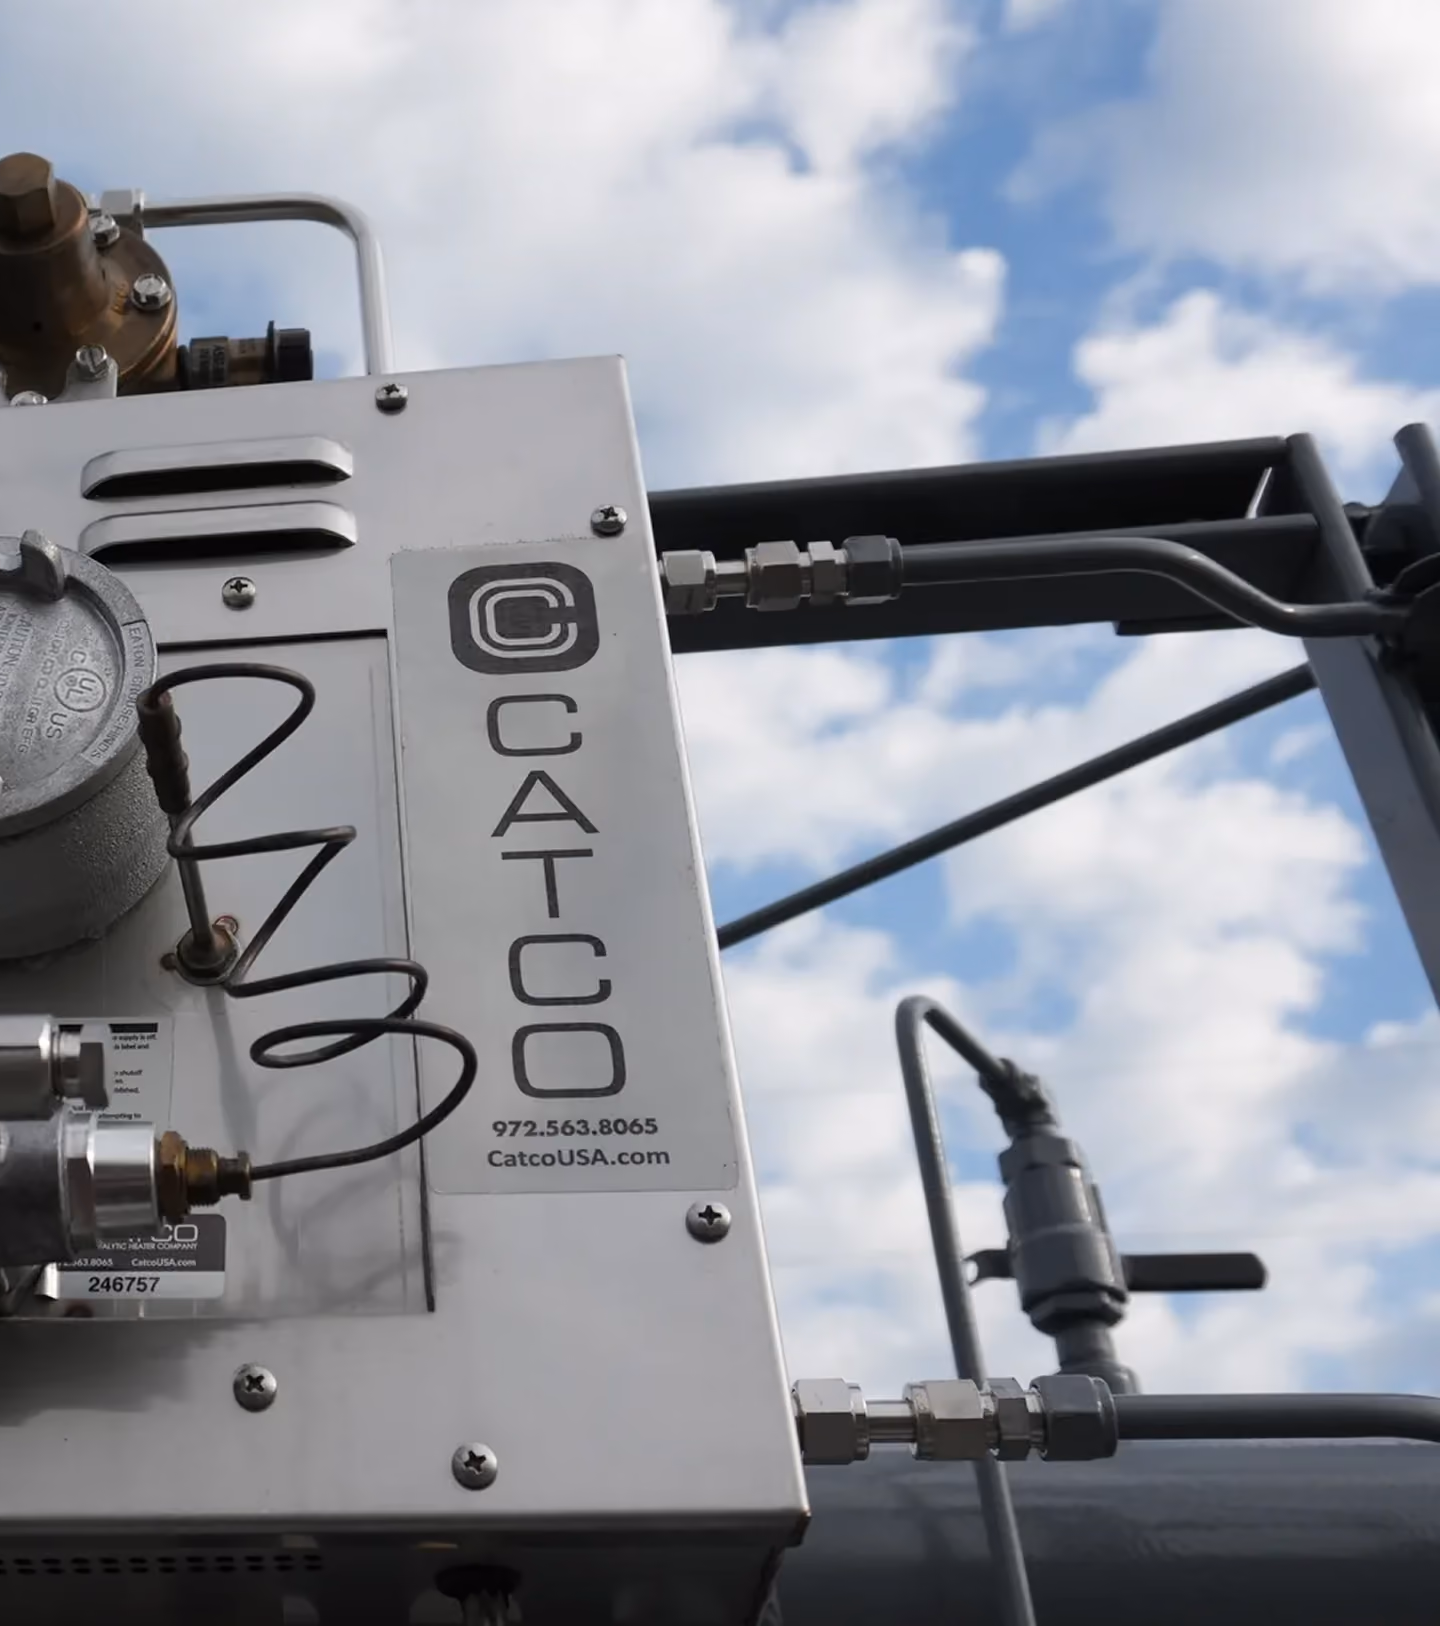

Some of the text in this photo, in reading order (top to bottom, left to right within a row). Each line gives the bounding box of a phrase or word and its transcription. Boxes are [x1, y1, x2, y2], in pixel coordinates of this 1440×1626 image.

[129, 626, 145, 668] EATON
[46, 712, 68, 740] US
[486, 693, 626, 1099] CATCO
[491, 1117, 658, 1139] 972.563.8065
[487, 1148, 670, 1168] CatcoUSA.com
[157, 1242, 198, 1250] COMPANY
[131, 1258, 197, 1267] CatcoUSA.com
[88, 1276, 160, 1292] 246757
